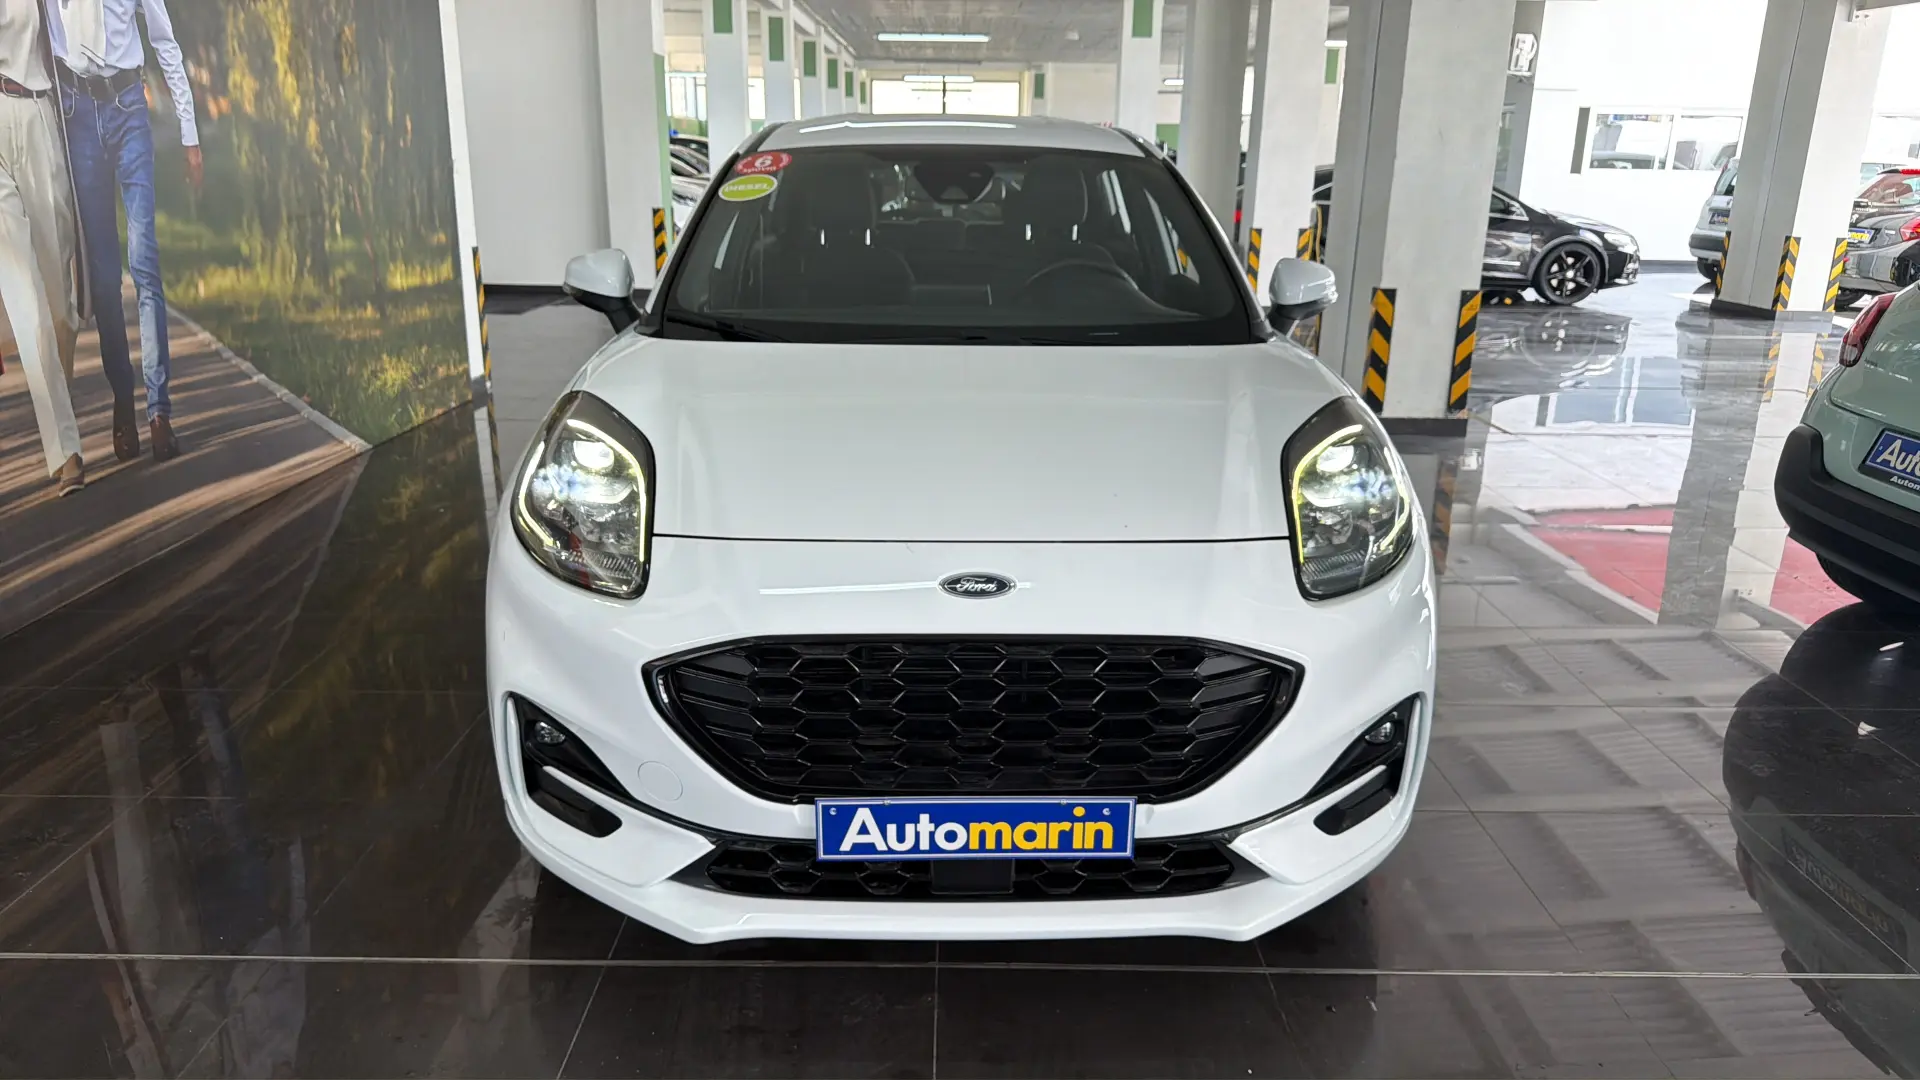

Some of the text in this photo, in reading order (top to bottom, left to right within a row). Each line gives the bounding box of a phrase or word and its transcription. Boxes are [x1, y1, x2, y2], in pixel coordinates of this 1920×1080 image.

[754, 155, 774, 168] 6
[955, 576, 998, 592] Ford
[838, 805, 1114, 852] Automarin
